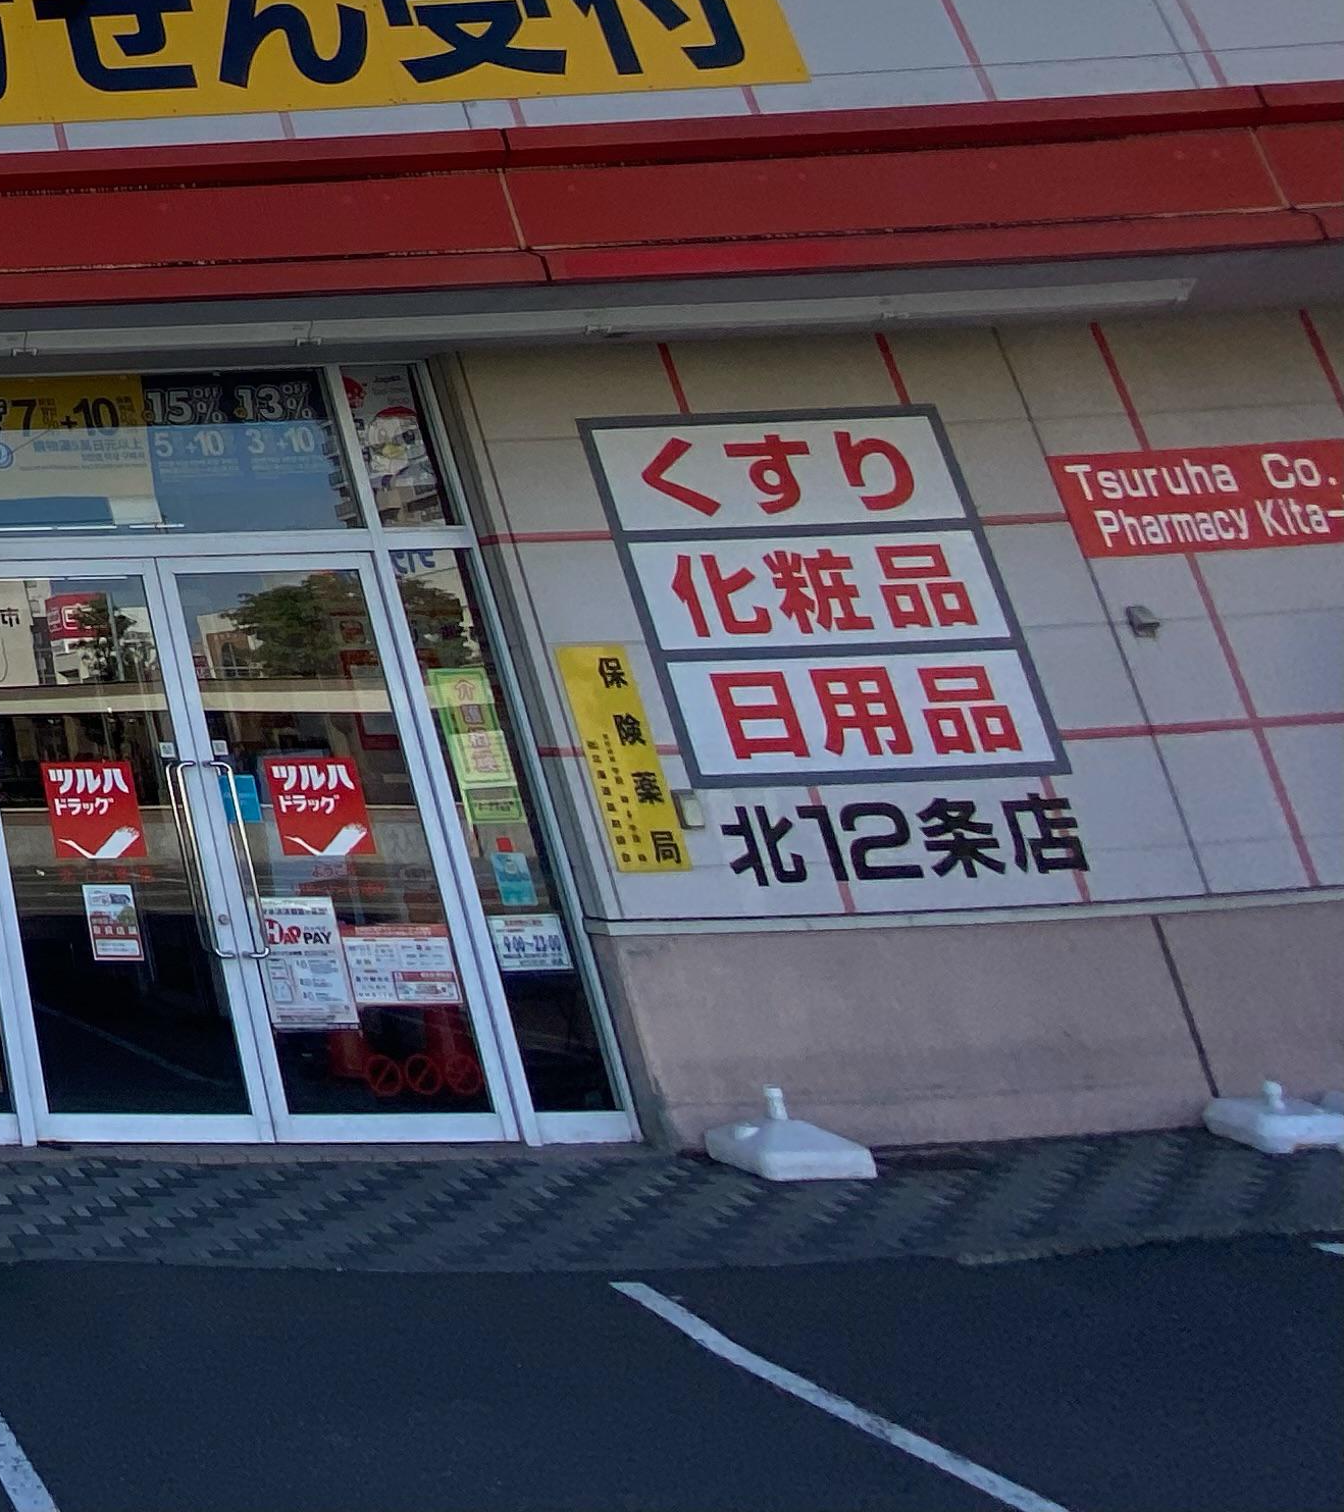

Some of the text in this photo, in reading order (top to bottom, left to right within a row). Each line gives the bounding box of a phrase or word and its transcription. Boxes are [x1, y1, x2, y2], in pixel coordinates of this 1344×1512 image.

[641, 430, 915, 516] くすり
[1064, 453, 1338, 501] Tsuruha Co.
[1093, 508, 1249, 548] Pharmacy
[670, 543, 980, 639] 化粧品
[708, 665, 1024, 760] 日用品
[47, 767, 130, 795] ツルハ
[271, 764, 356, 791] ツルハ
[597, 657, 683, 865] 保険薬局
[54, 797, 114, 816] ドラッグ
[278, 794, 340, 815] ドラッグ
[720, 793, 1090, 888] 北12条店
